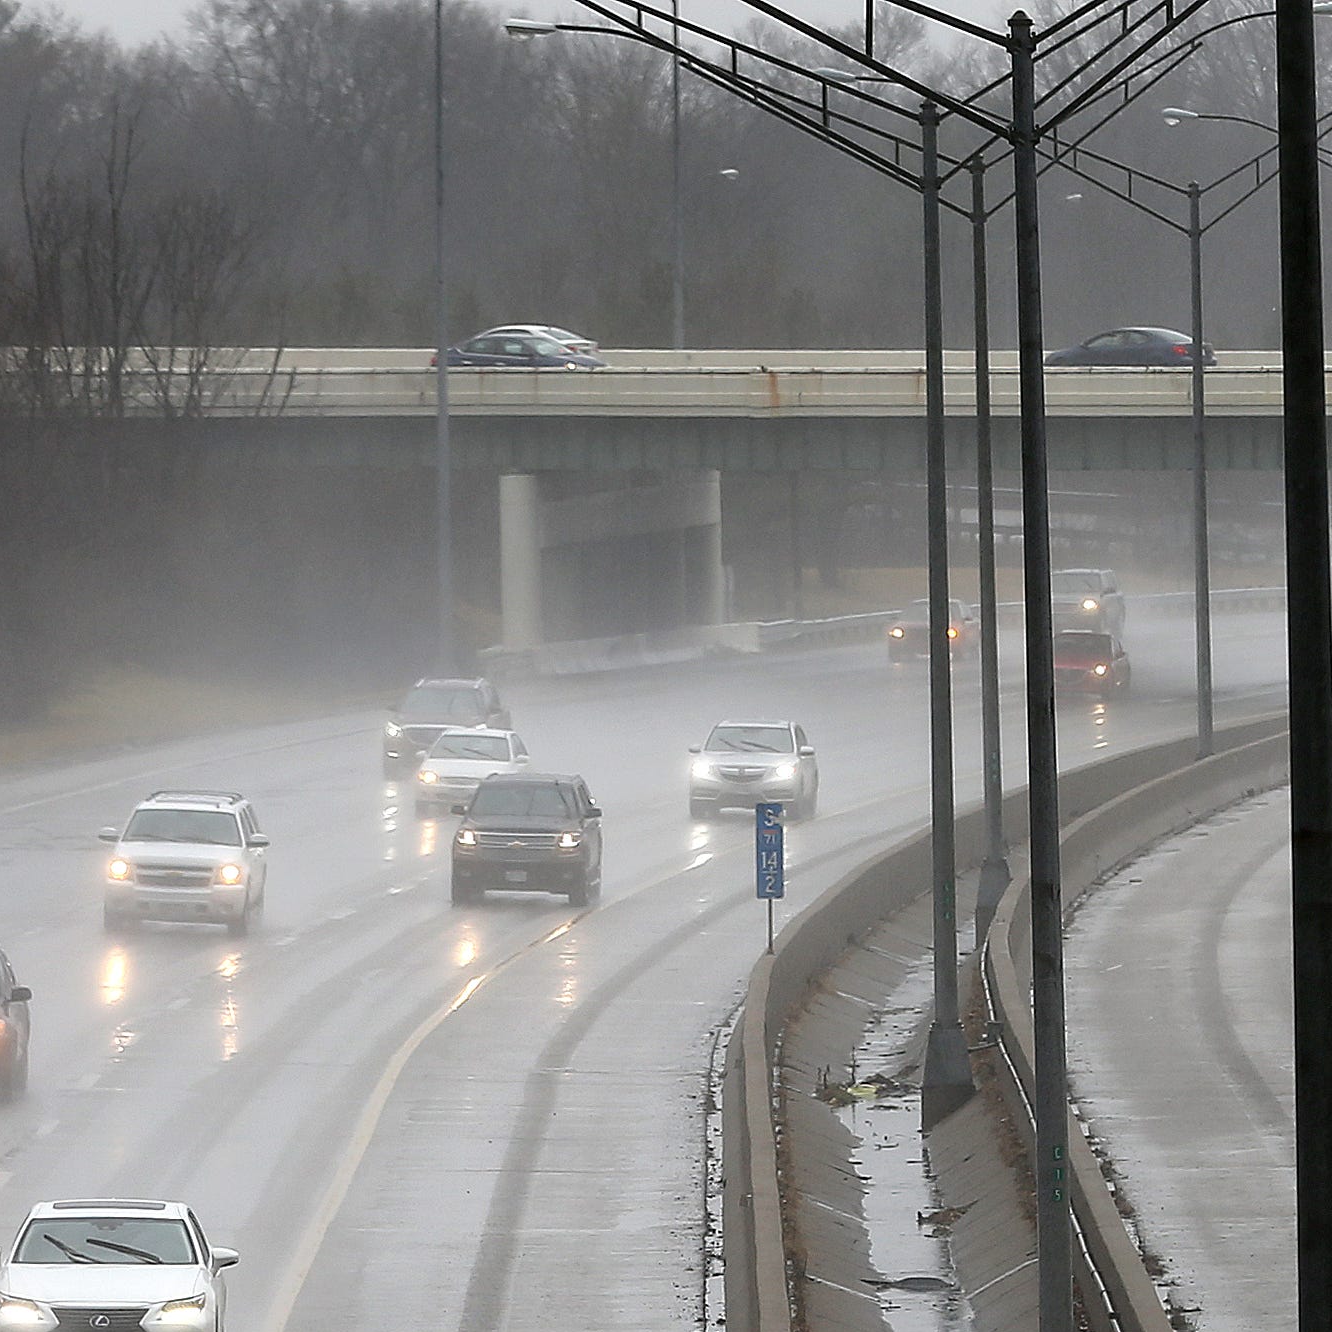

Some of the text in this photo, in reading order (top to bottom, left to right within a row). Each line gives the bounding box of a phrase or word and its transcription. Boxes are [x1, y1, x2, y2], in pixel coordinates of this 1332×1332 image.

[764, 834, 776, 844] 71
[761, 851, 778, 869] 14
[765, 875, 776, 893] 2
